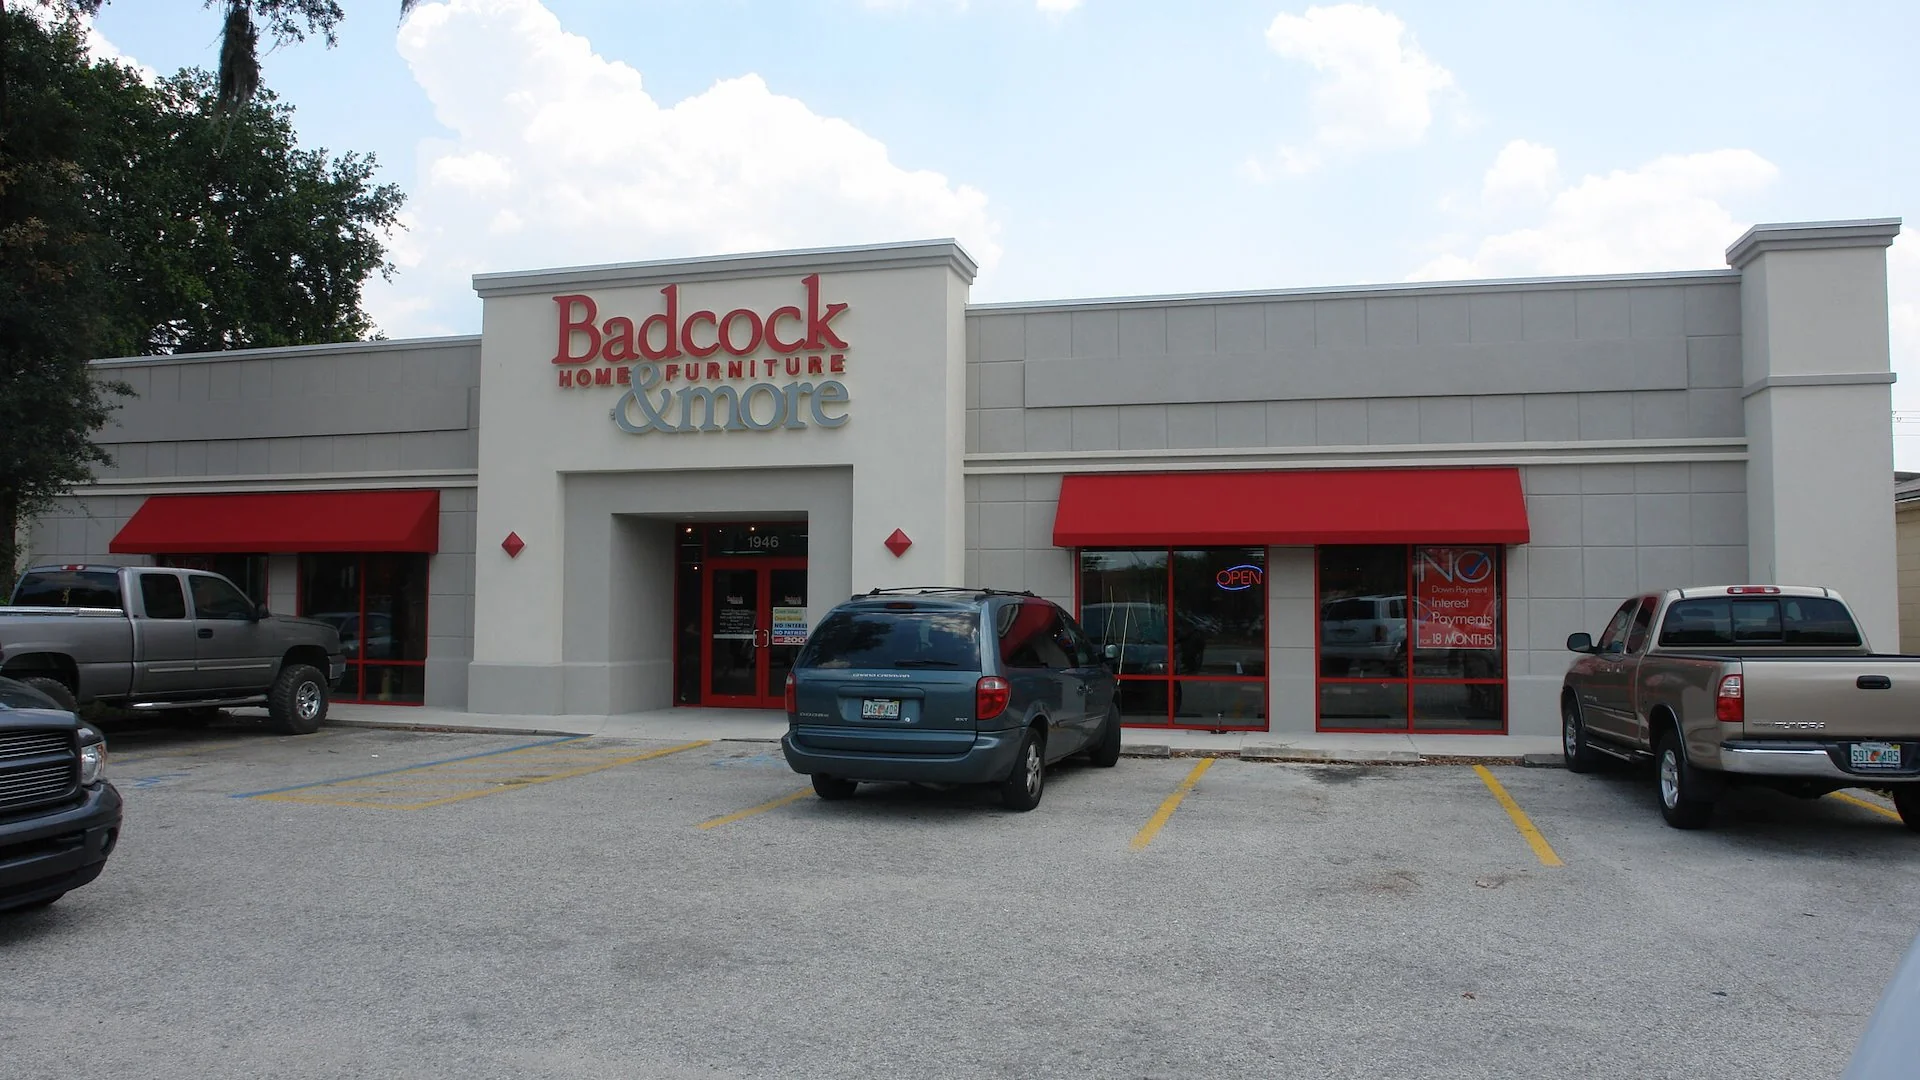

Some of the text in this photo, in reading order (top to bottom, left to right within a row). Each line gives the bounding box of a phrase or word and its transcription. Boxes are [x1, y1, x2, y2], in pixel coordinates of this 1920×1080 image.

[551, 272, 849, 365] Badcock
[558, 354, 846, 388] HOME FURNITURE
[748, 535, 779, 548] 1946
[1420, 550, 1492, 583] NO
[1216, 570, 1262, 585] OPEN
[1431, 585, 1488, 595] Down Payment
[1431, 597, 1469, 608] Interest
[1432, 612, 1493, 629] Payments
[1432, 633, 1442, 645] 18
[1445, 633, 1493, 645] MONTHS
